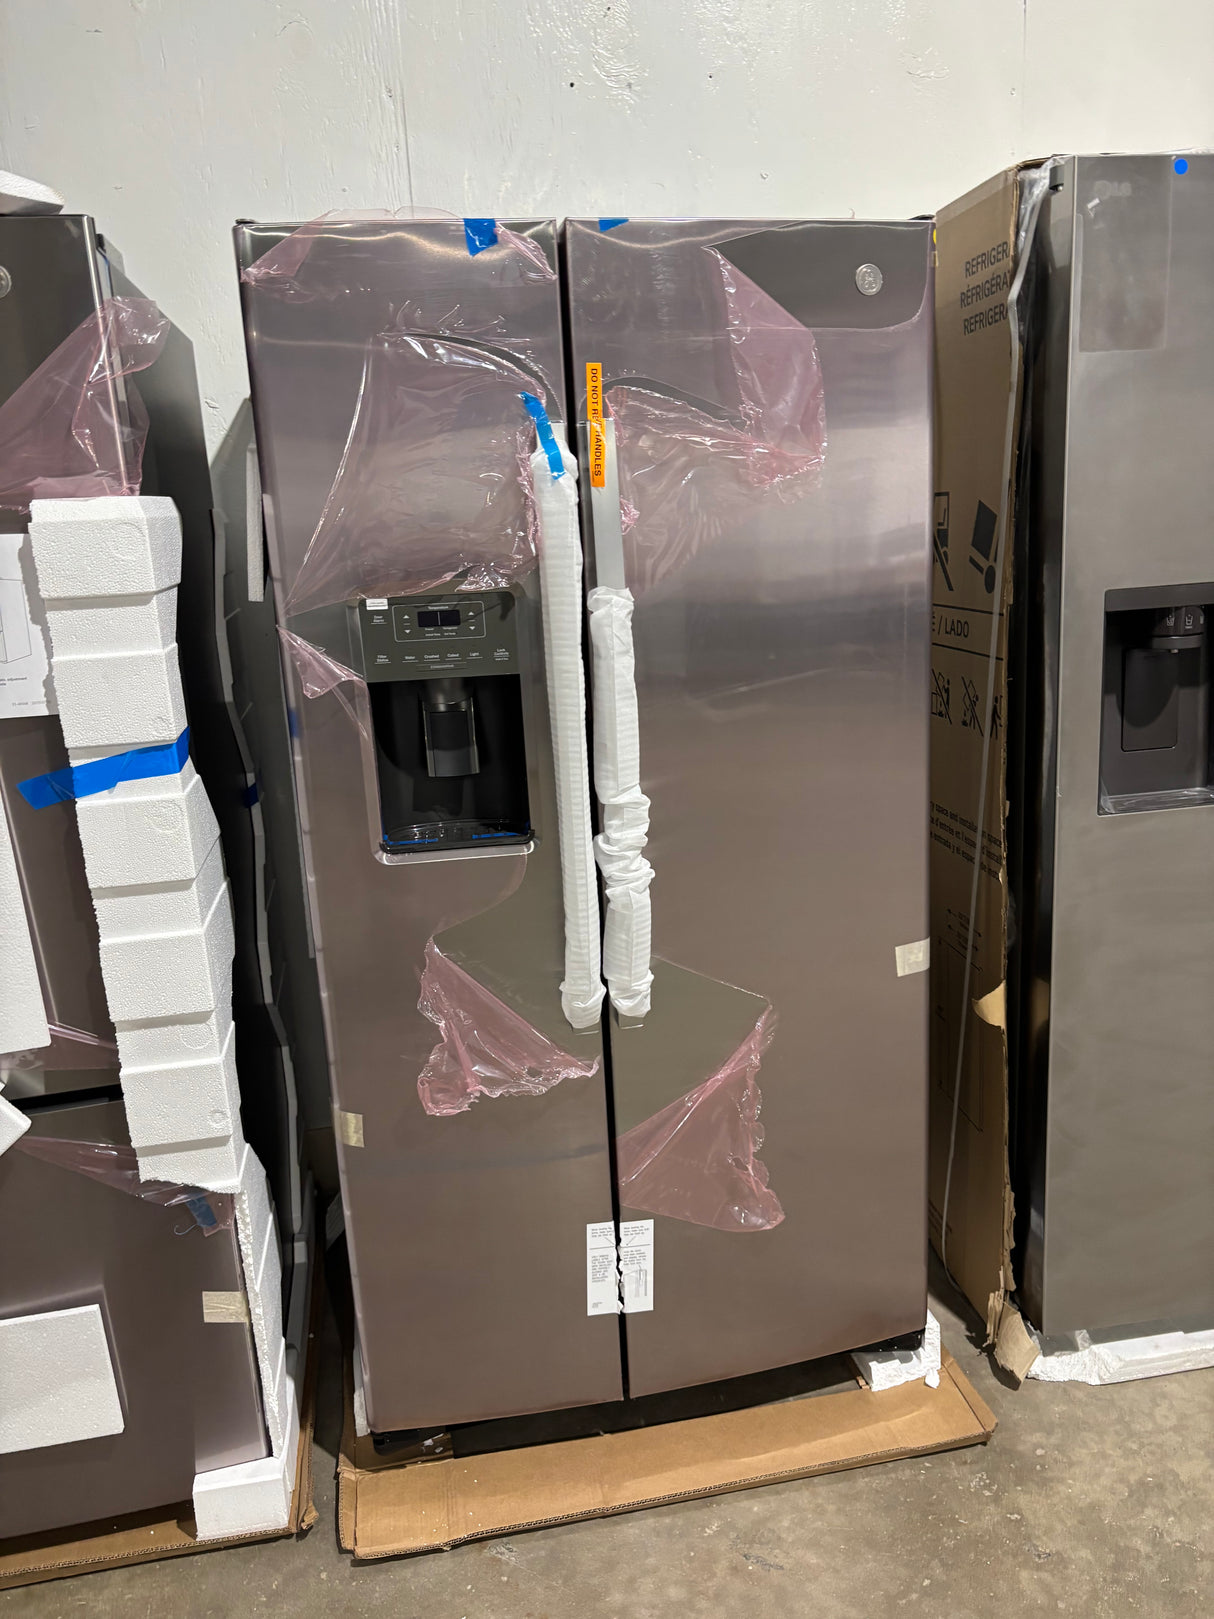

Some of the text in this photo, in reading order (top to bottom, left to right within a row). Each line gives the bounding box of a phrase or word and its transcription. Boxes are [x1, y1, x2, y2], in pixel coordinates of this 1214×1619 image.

[965, 241, 1010, 279] REFRIGER
[960, 270, 1010, 309] RÉFRIGÉRA
[590, 368, 598, 383] DO
[591, 386, 599, 406] NOT
[594, 431, 602, 477] HANDLES
[945, 617, 970, 638] LADO
